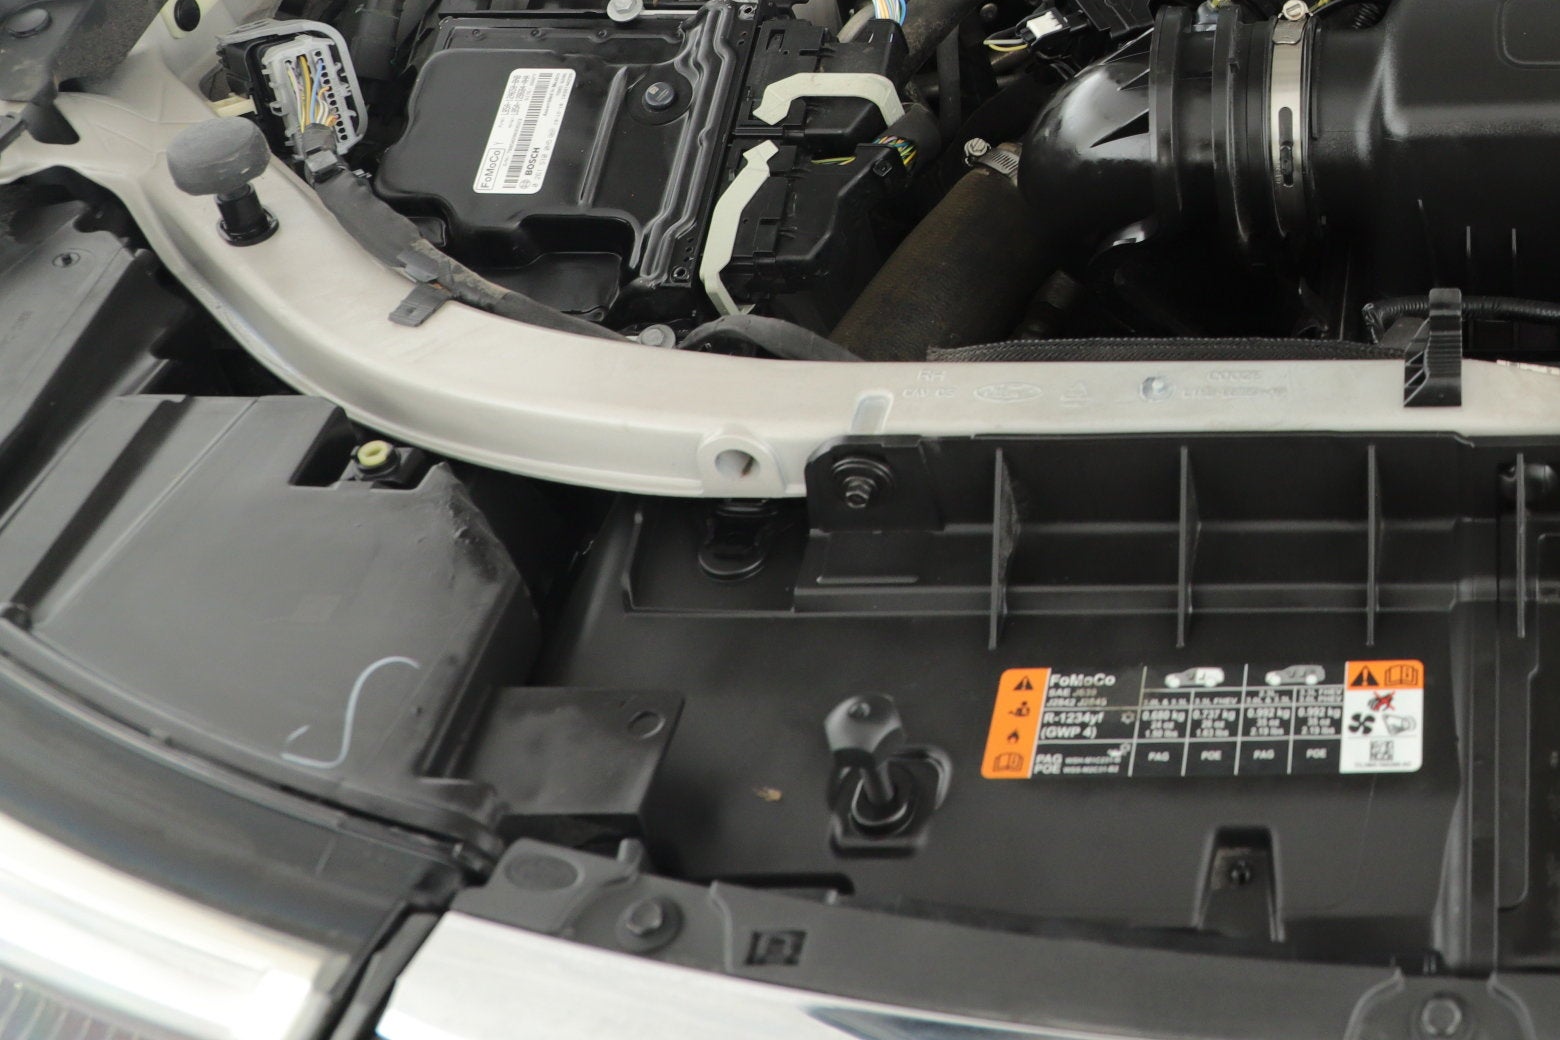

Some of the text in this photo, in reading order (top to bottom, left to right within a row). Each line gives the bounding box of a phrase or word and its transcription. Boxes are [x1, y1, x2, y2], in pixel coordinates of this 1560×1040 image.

[525, 147, 540, 176] BOSCH
[480, 149, 501, 188] FoMoCo
[1050, 672, 1117, 687] FoMoCo
[1048, 688, 1071, 698] SAE
[1043, 711, 1105, 726] R-1234yf
[1041, 725, 1098, 740] (GWP 4)
[1035, 752, 1063, 764] PAG
[1148, 750, 1170, 762] PAG
[1201, 749, 1223, 761] POE
[1253, 748, 1275, 760] PAG
[1306, 747, 1328, 759] POE
[1033, 763, 1062, 775] POE
